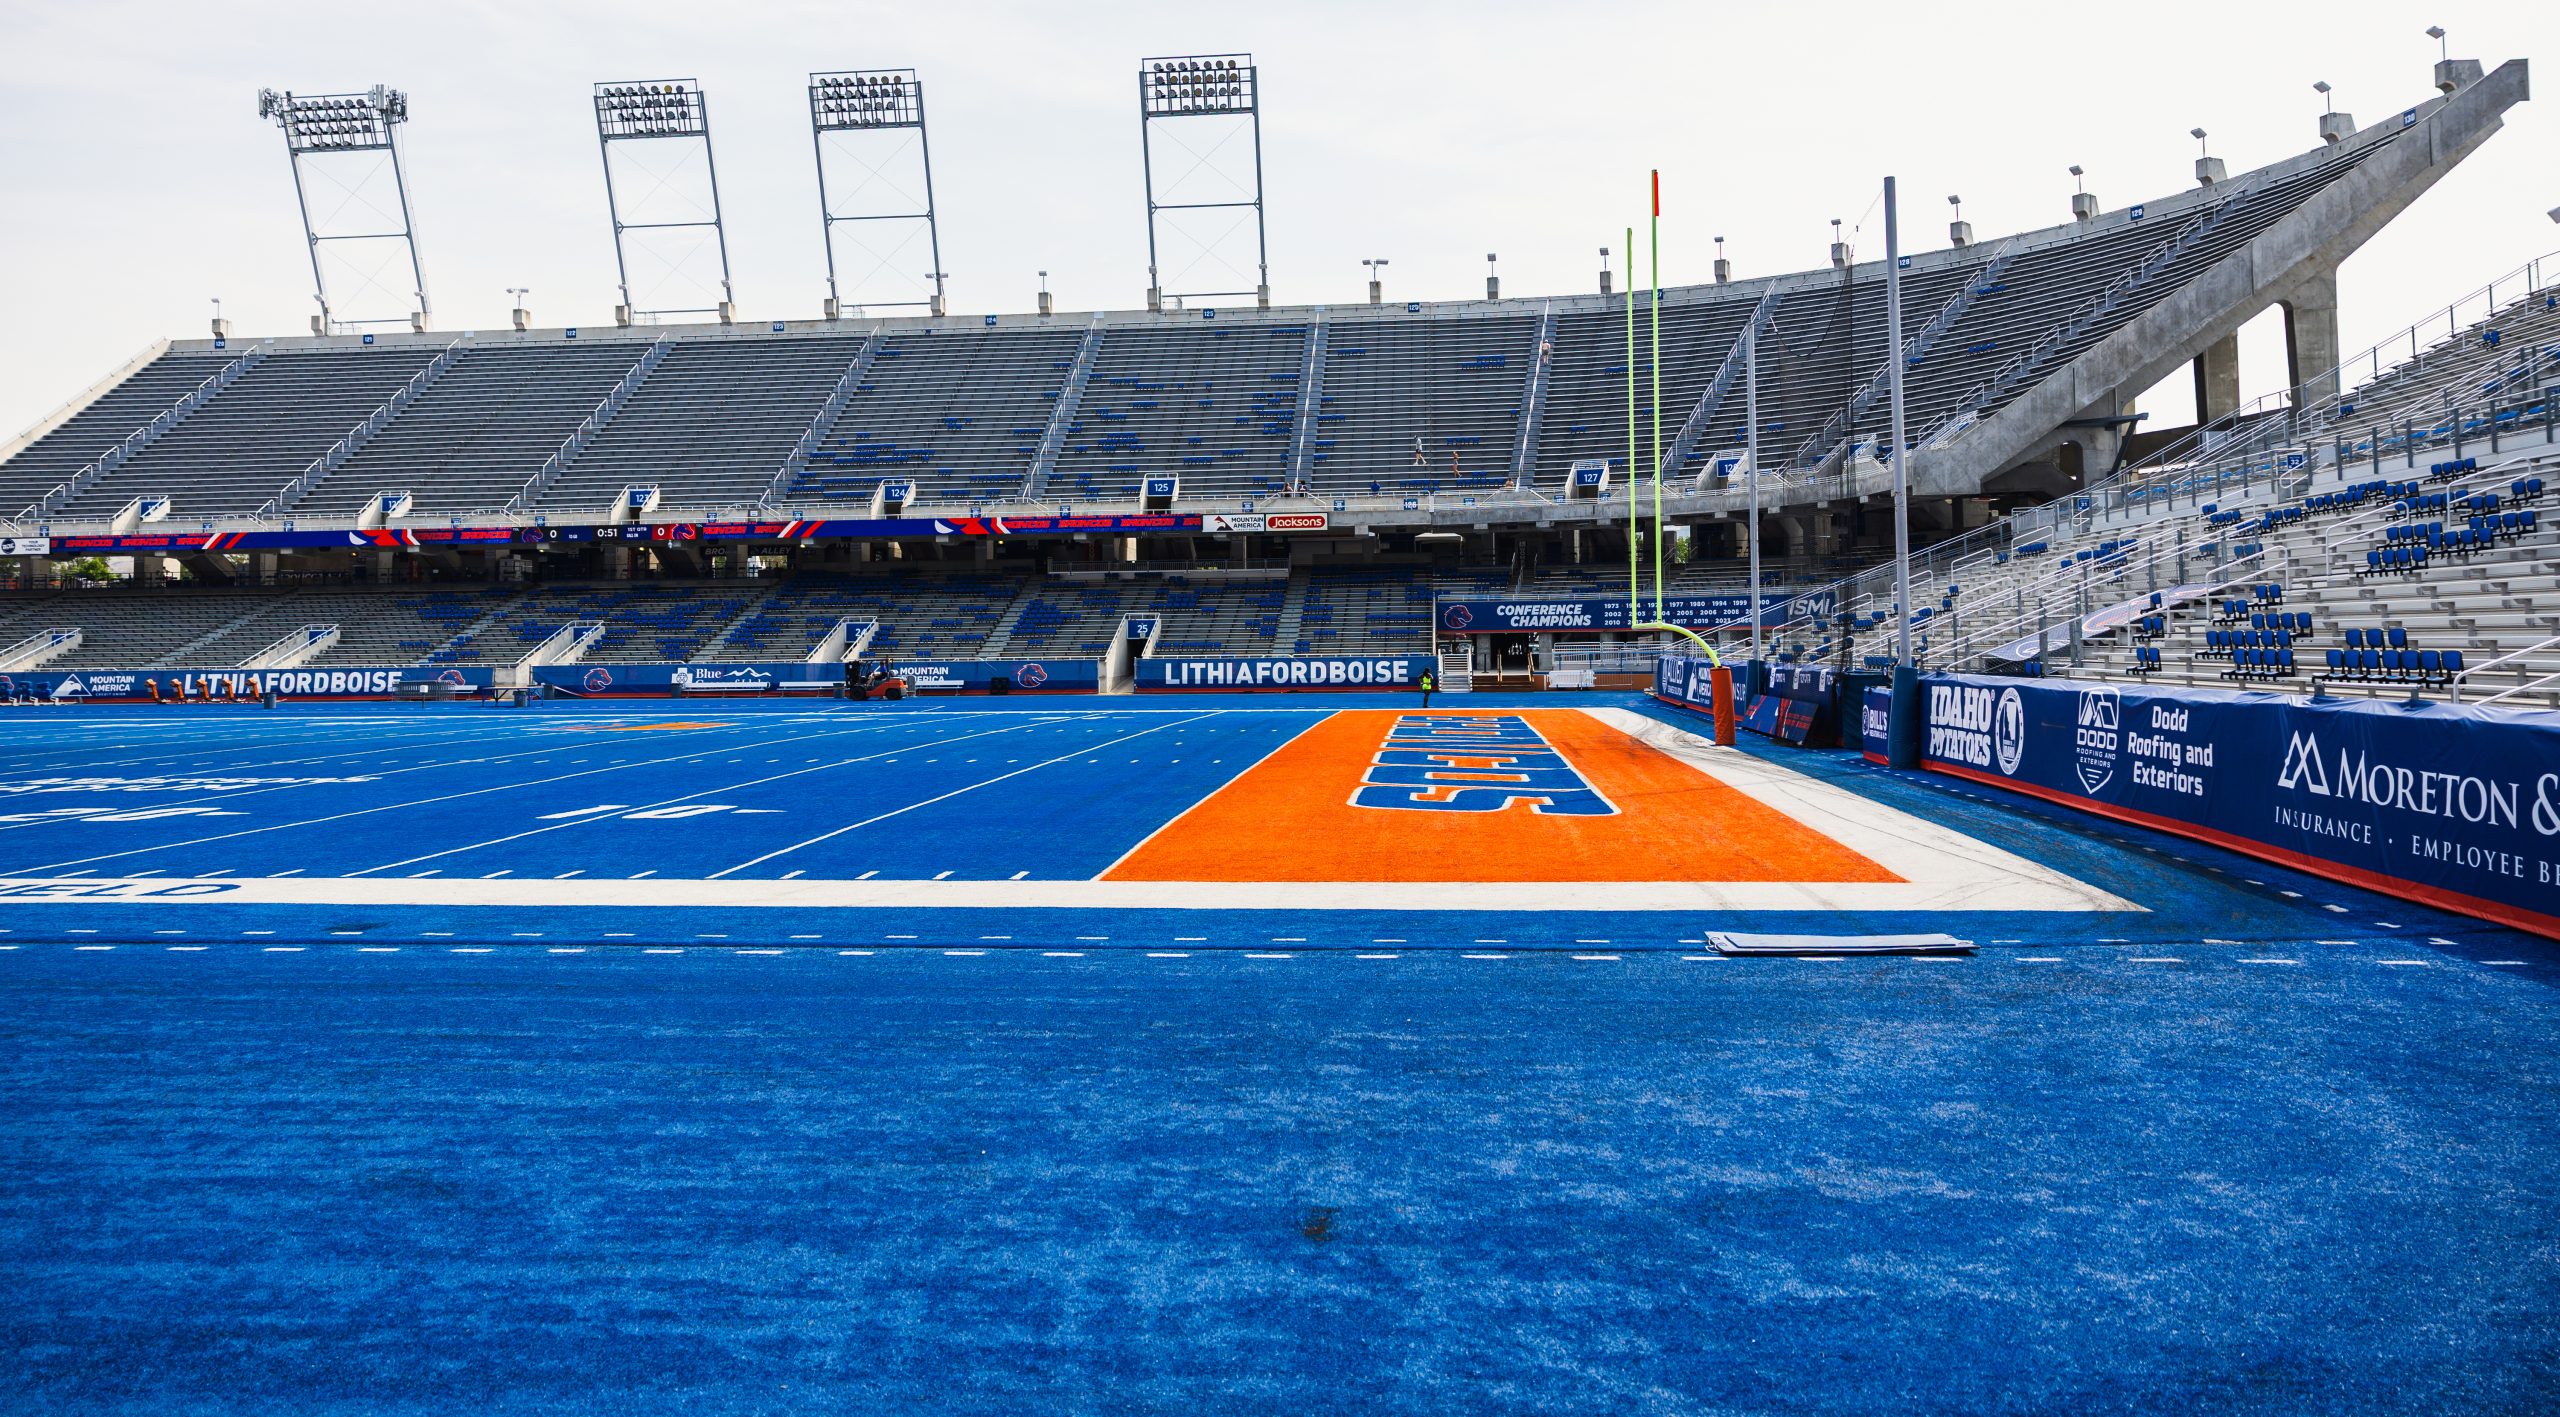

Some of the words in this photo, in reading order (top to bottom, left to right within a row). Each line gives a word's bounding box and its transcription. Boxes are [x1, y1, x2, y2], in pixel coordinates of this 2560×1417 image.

[1584, 474, 1598, 483] 127
[892, 489, 905, 497] 124
[1272, 517, 1322, 529] Jacksons
[550, 530, 557, 538] 0
[597, 529, 617, 537] 0:51
[657, 528, 664, 536] 0
[1497, 604, 1582, 616] CONFERENCE
[1511, 615, 1591, 626] CHAMPIONS
[1137, 625, 1148, 633] 25
[696, 668, 722, 679] Blue
[900, 667, 949, 675] MOUNTAIN
[1166, 661, 1409, 684] LITHIAFORDBOISE
[90, 676, 134, 685] MOUNTAIN
[92, 684, 130, 693] AMERICA
[1930, 686, 1991, 732] IDAHO
[1870, 709, 1888, 731] BILL'S
[2152, 706, 2188, 731] Dodd
[2077, 728, 2117, 751] DODD
[1930, 727, 1991, 767] POTATOES
[2127, 731, 2180, 766] Roofing
[2186, 743, 2213, 766] and
[2077, 747, 2103, 757] ROOFING
[2104, 752, 2116, 760] AND
[2080, 757, 2111, 767] EXTERIORS
[2133, 761, 2203, 795] Exteriors
[2335, 747, 2520, 829] MORETON
[2532, 773, 2560, 835] &
[536, 805, 738, 819] 10
[2275, 806, 2371, 844] INSURANCE
[2412, 835, 2524, 878] EMPLOYEE
[0, 884, 241, 897] IELD
